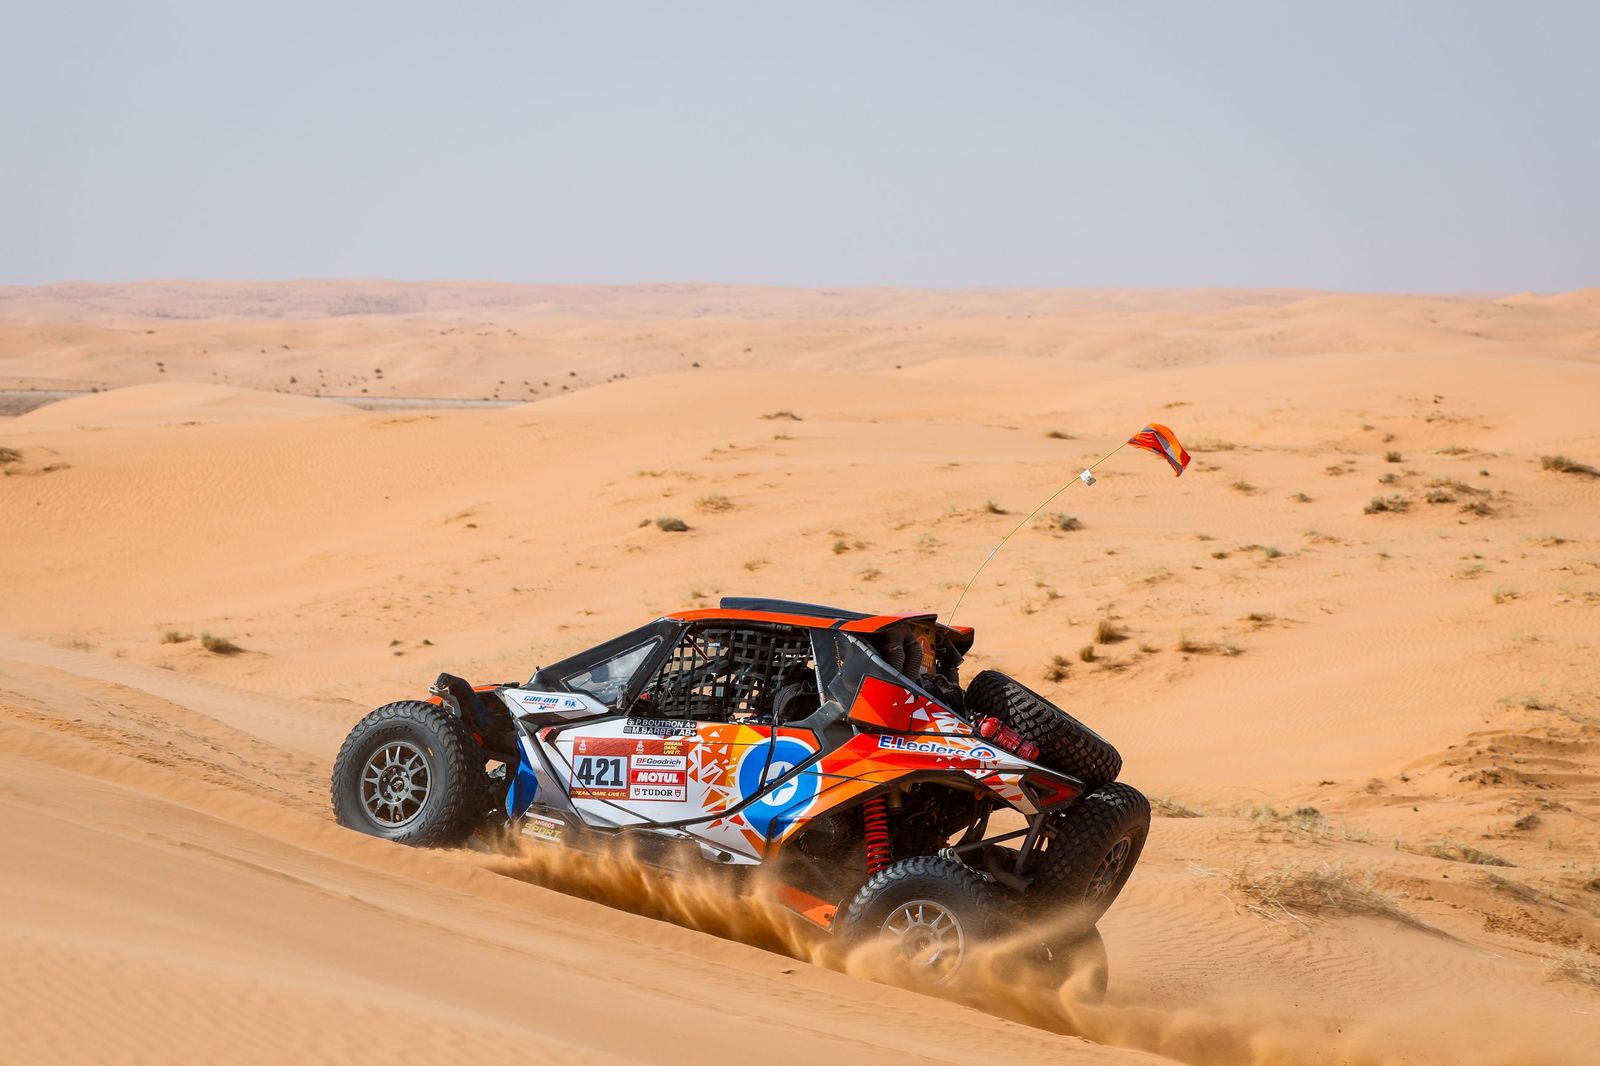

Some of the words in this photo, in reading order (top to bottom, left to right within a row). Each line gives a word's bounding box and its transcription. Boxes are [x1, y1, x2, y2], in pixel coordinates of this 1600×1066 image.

[523, 695, 559, 704] can-am
[678, 729, 697, 737] AB+
[879, 735, 967, 756] E.Leclerc
[636, 757, 681, 766] BFGoodrich
[577, 757, 623, 787] 421
[637, 771, 679, 783] MOTUL
[642, 788, 673, 797] TUDOR
[524, 822, 561, 838] SPORT
